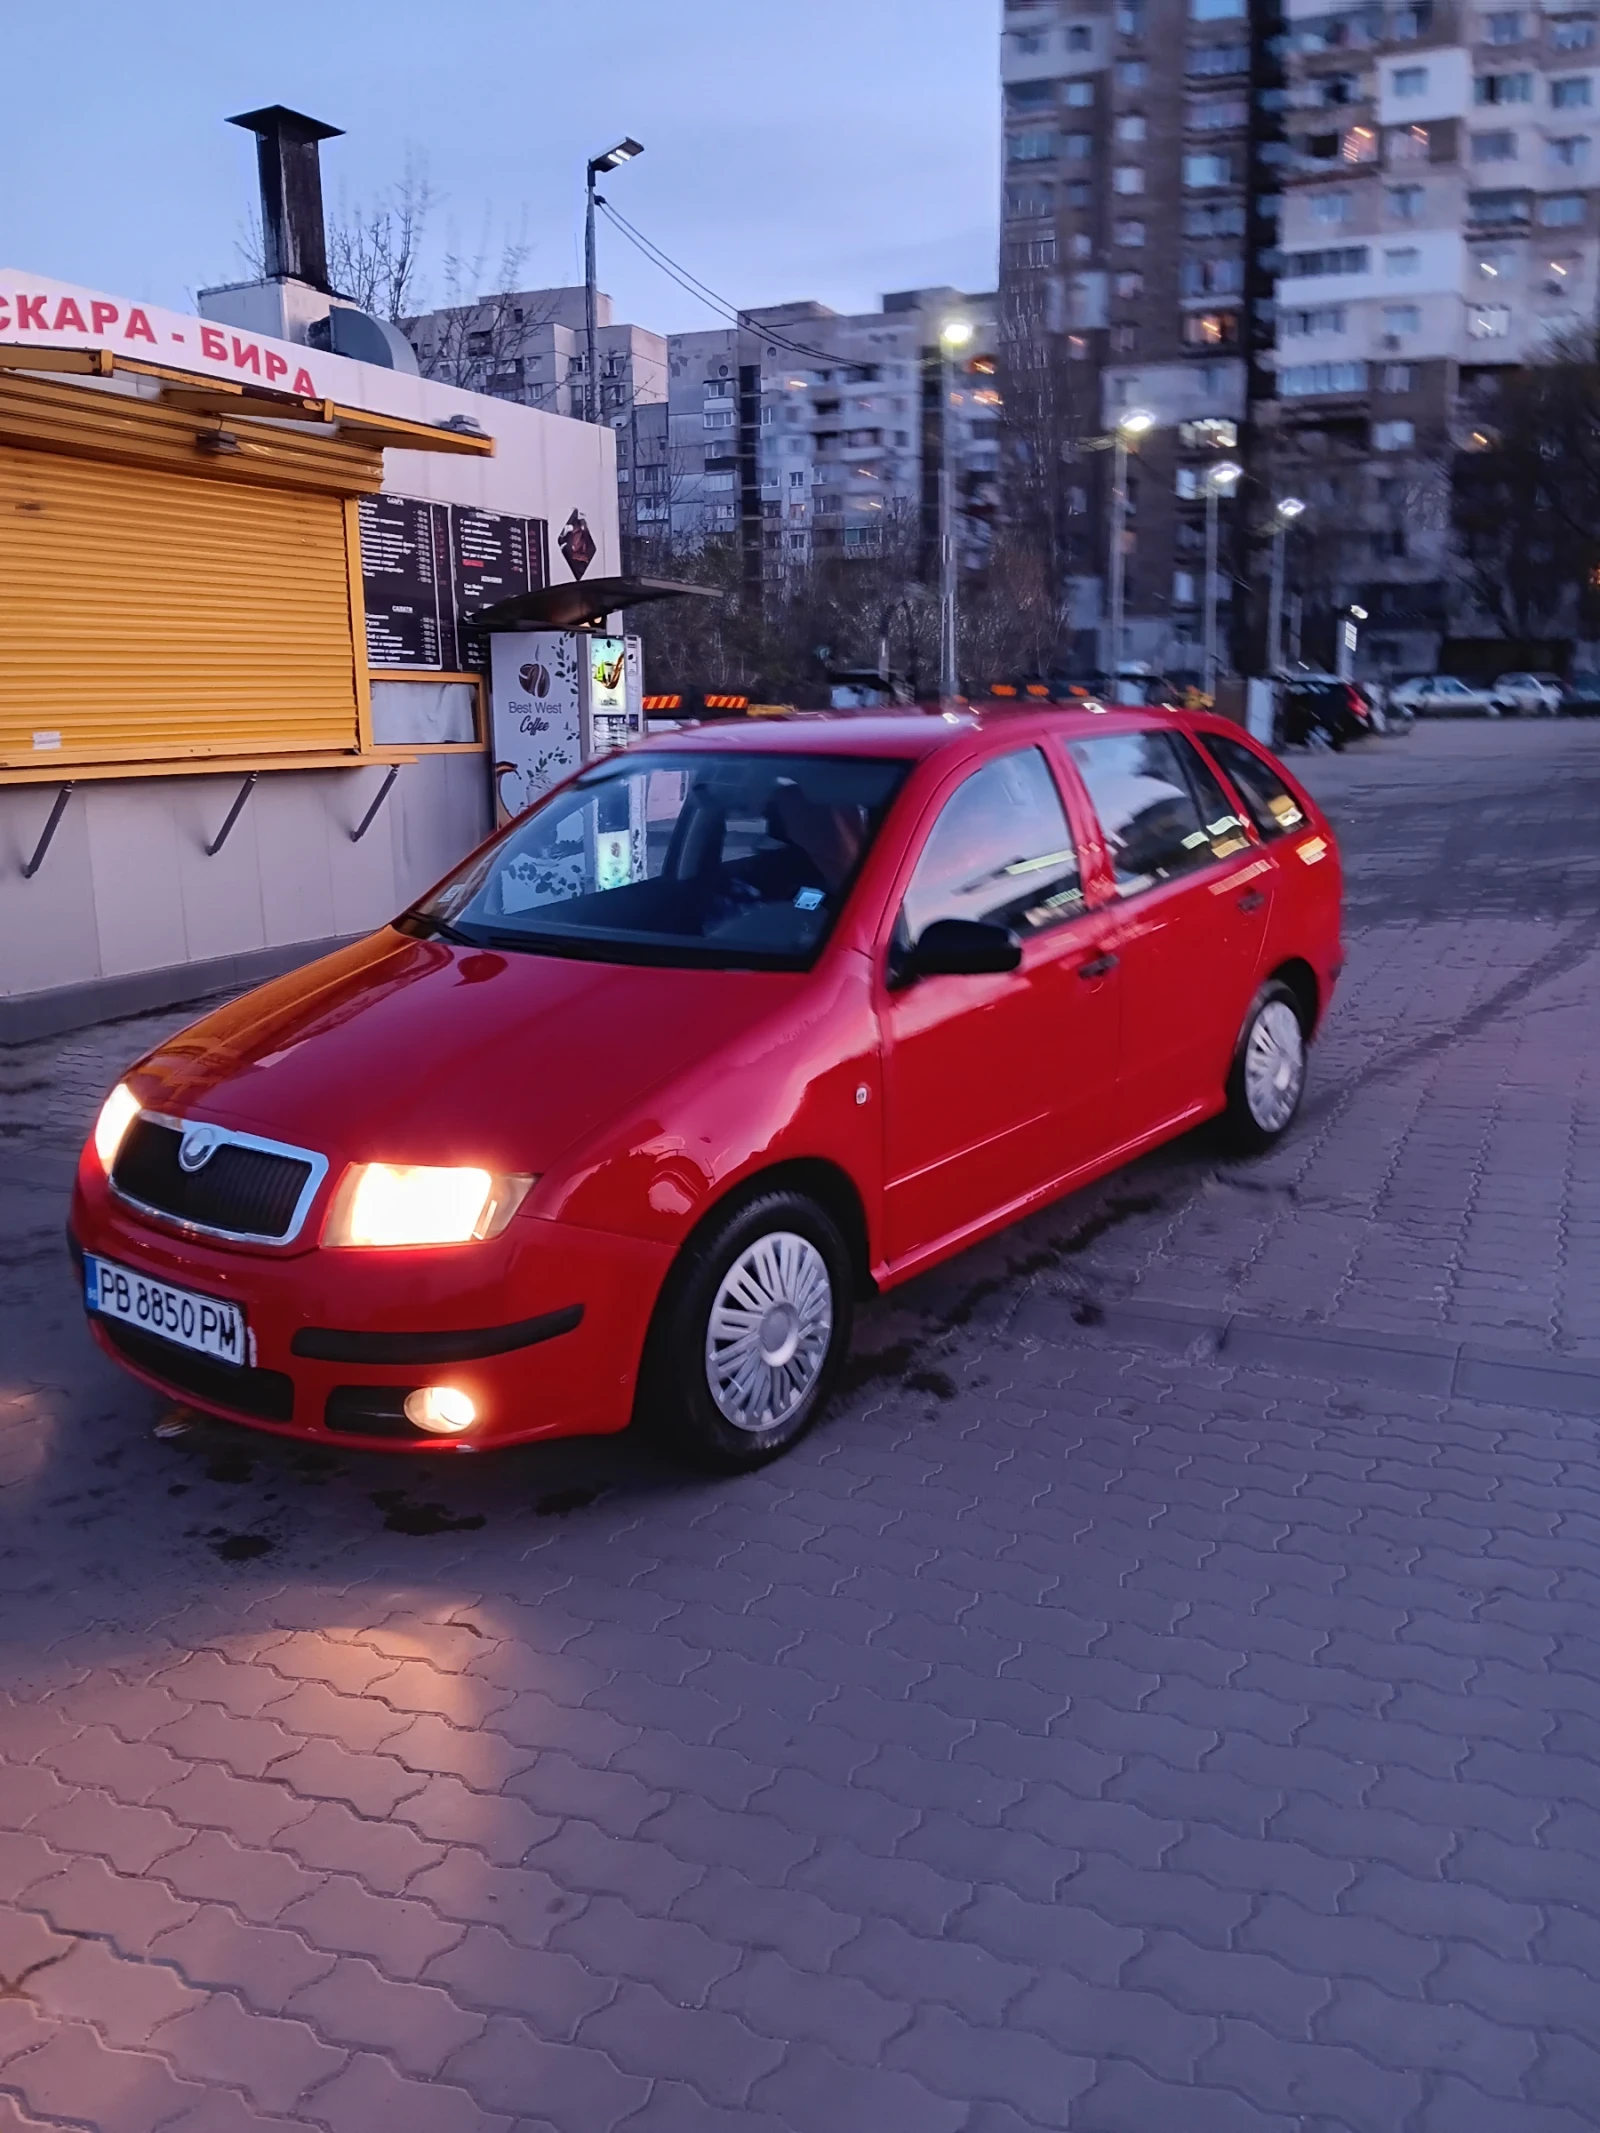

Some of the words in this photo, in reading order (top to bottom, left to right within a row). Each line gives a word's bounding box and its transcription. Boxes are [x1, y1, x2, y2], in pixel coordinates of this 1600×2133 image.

[200, 325, 317, 398] БИРА
[508, 701, 532, 714] Best
[534, 701, 562, 714] West
[519, 715, 550, 736] Coffee
[101, 1268, 130, 1313] PB
[137, 1282, 195, 1338] 8850
[200, 1304, 236, 1355] PM
